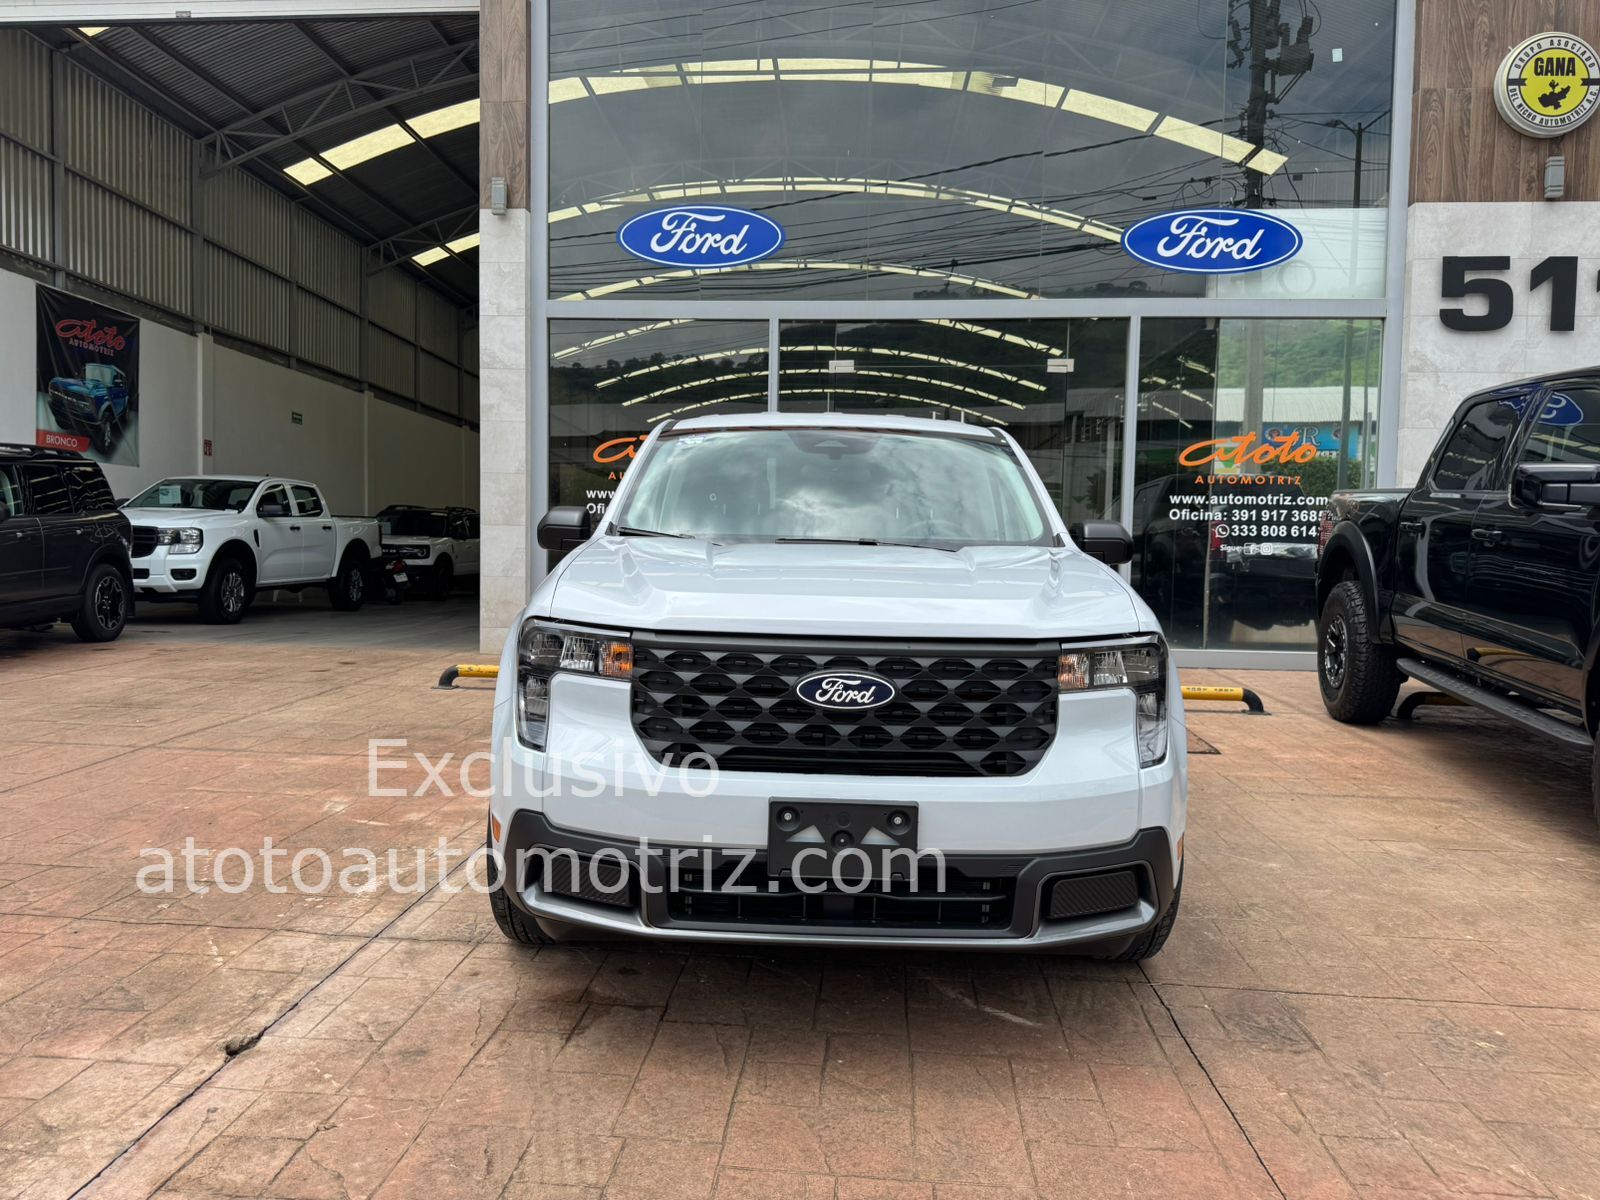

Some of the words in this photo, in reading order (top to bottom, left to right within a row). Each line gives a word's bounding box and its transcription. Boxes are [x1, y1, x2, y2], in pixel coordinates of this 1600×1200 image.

[1514, 42, 1542, 69] GRUPO
[1549, 40, 1596, 68] ASOCIADO
[1534, 57, 1576, 76] GANA
[1509, 87, 1517, 103] DEL
[1516, 103, 1537, 121] NICHO
[1538, 104, 1588, 126] AUTOMOTRIZ
[649, 211, 750, 256] Ford
[1156, 215, 1265, 260] Ford
[1439, 255, 1600, 332] 51
[68, 338, 114, 356] AUTOMOTRIZ
[46, 434, 78, 448] BRONCO
[1194, 475, 1301, 485] AUTOMOTRIZ
[1169, 493, 1329, 506] www.automotriz.com
[1169, 508, 1228, 521] Oficina:
[1231, 509, 1257, 522] 391
[1261, 509, 1288, 522] 917
[1231, 525, 1258, 538] 333
[1261, 525, 1288, 538] 808
[1291, 525, 1320, 538] 614
[815, 677, 876, 703] Ford
